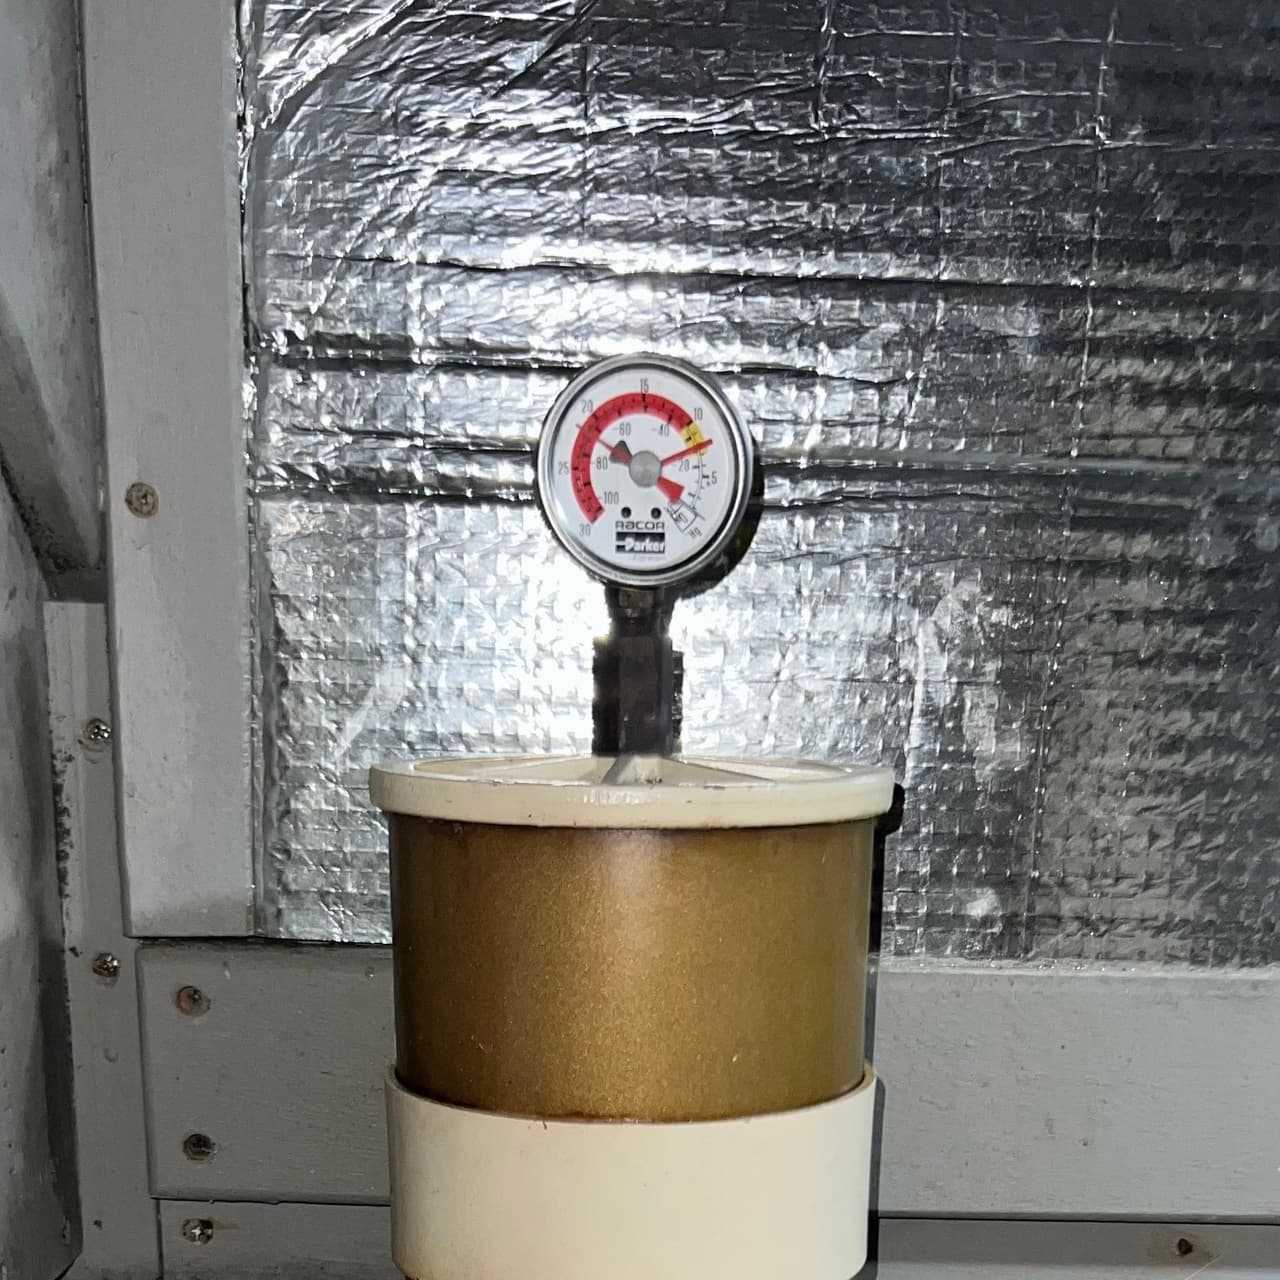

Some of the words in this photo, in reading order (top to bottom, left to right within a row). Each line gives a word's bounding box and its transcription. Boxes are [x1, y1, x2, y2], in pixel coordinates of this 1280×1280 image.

[640, 378, 649, 393] 15
[582, 399, 593, 413] 20
[694, 407, 703, 420] 10
[558, 461, 569, 475] 25
[579, 523, 591, 536] 30
[625, 536, 665, 551] Parker
